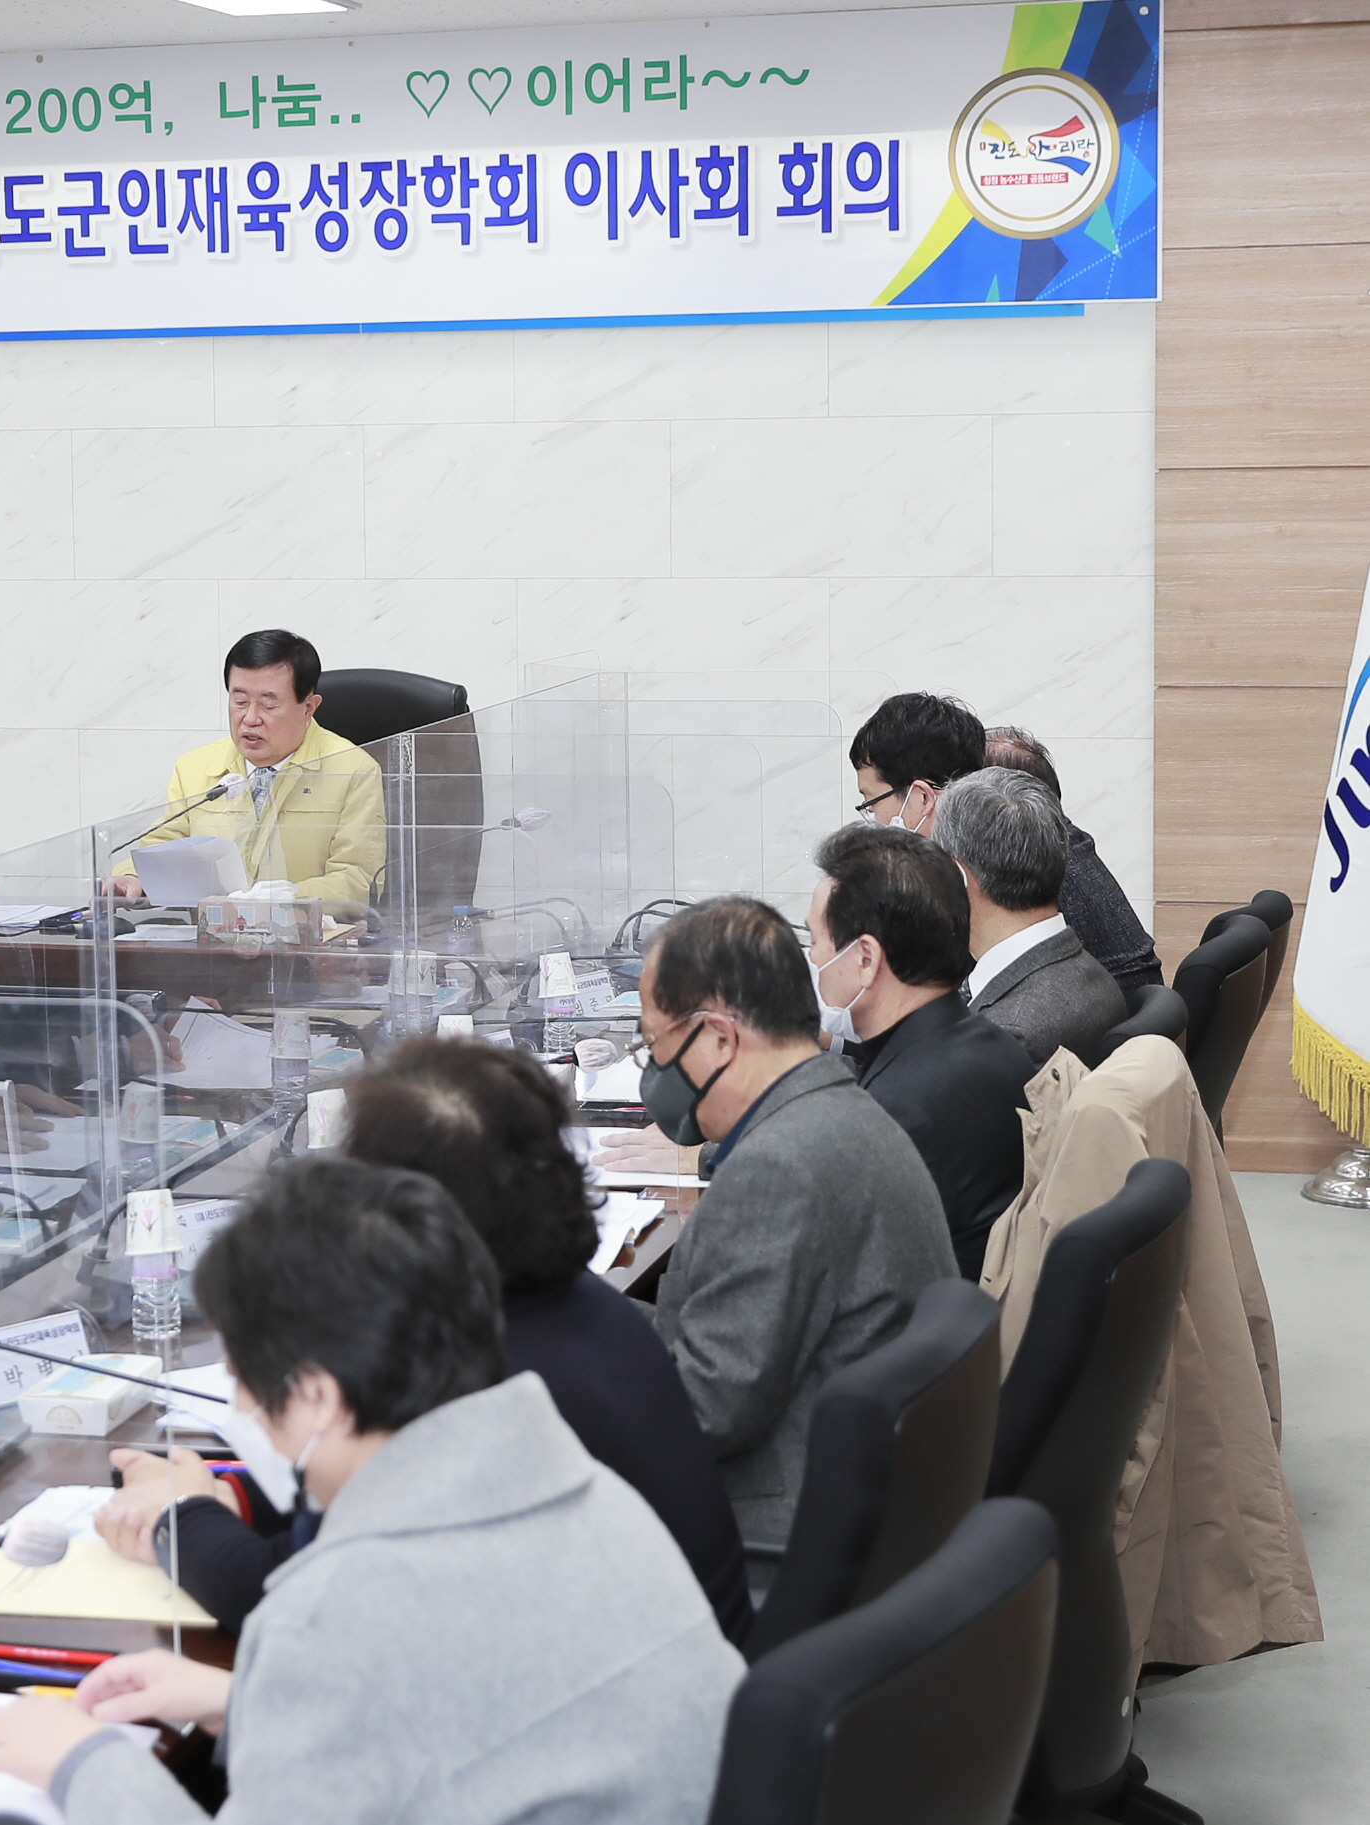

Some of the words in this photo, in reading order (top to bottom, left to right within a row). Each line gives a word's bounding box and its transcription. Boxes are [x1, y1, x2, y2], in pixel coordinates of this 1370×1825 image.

[6, 80, 174, 134] 200억,
[565, 145, 750, 241] 이사회
[776, 139, 900, 234] 회의
